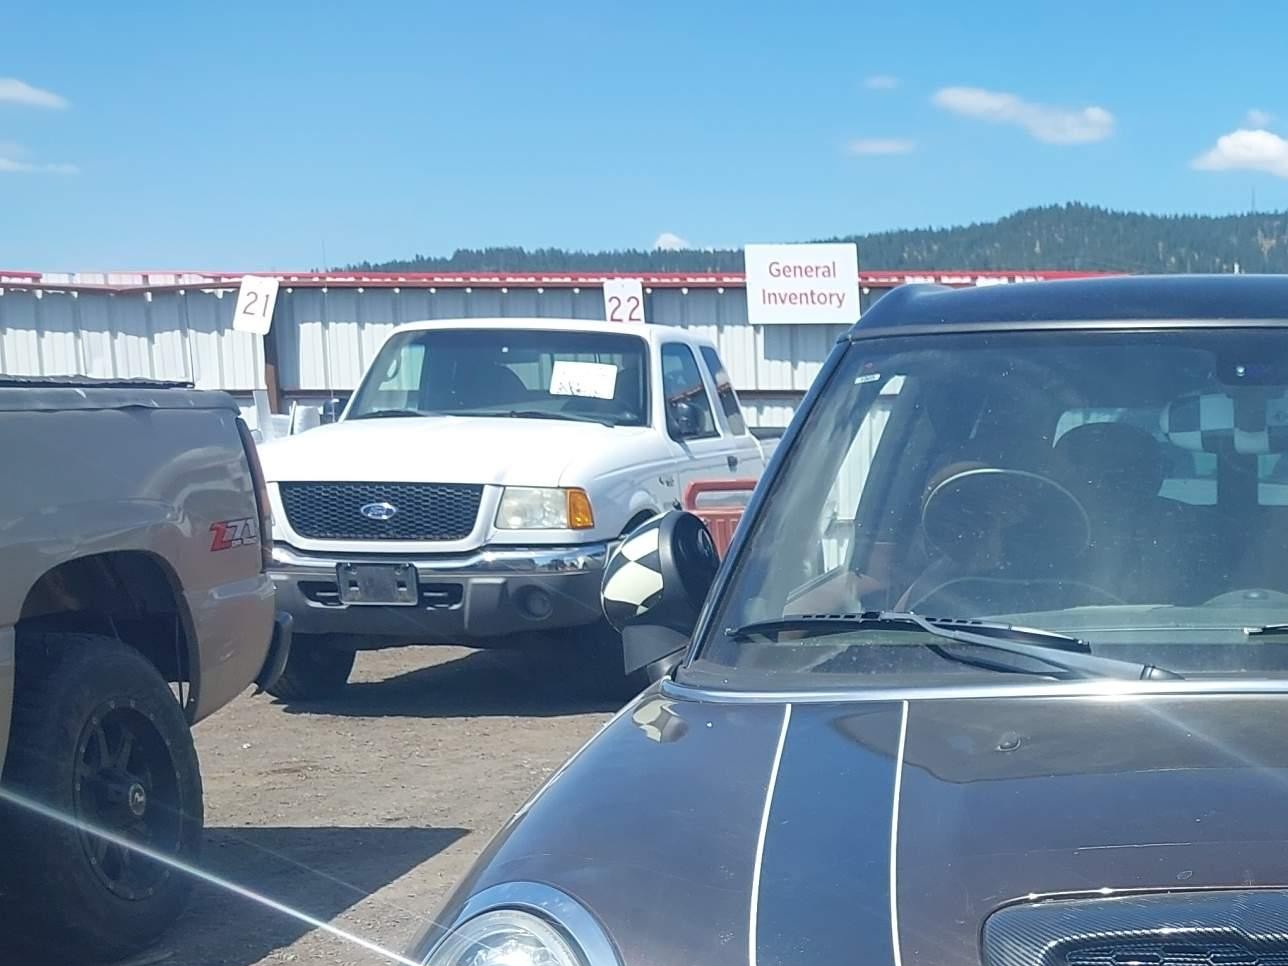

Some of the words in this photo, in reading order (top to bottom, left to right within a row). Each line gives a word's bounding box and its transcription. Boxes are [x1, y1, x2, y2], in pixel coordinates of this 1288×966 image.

[768, 261, 836, 278] General
[242, 291, 270, 317] 21
[608, 296, 641, 322] 22
[762, 289, 846, 308] Inventory
